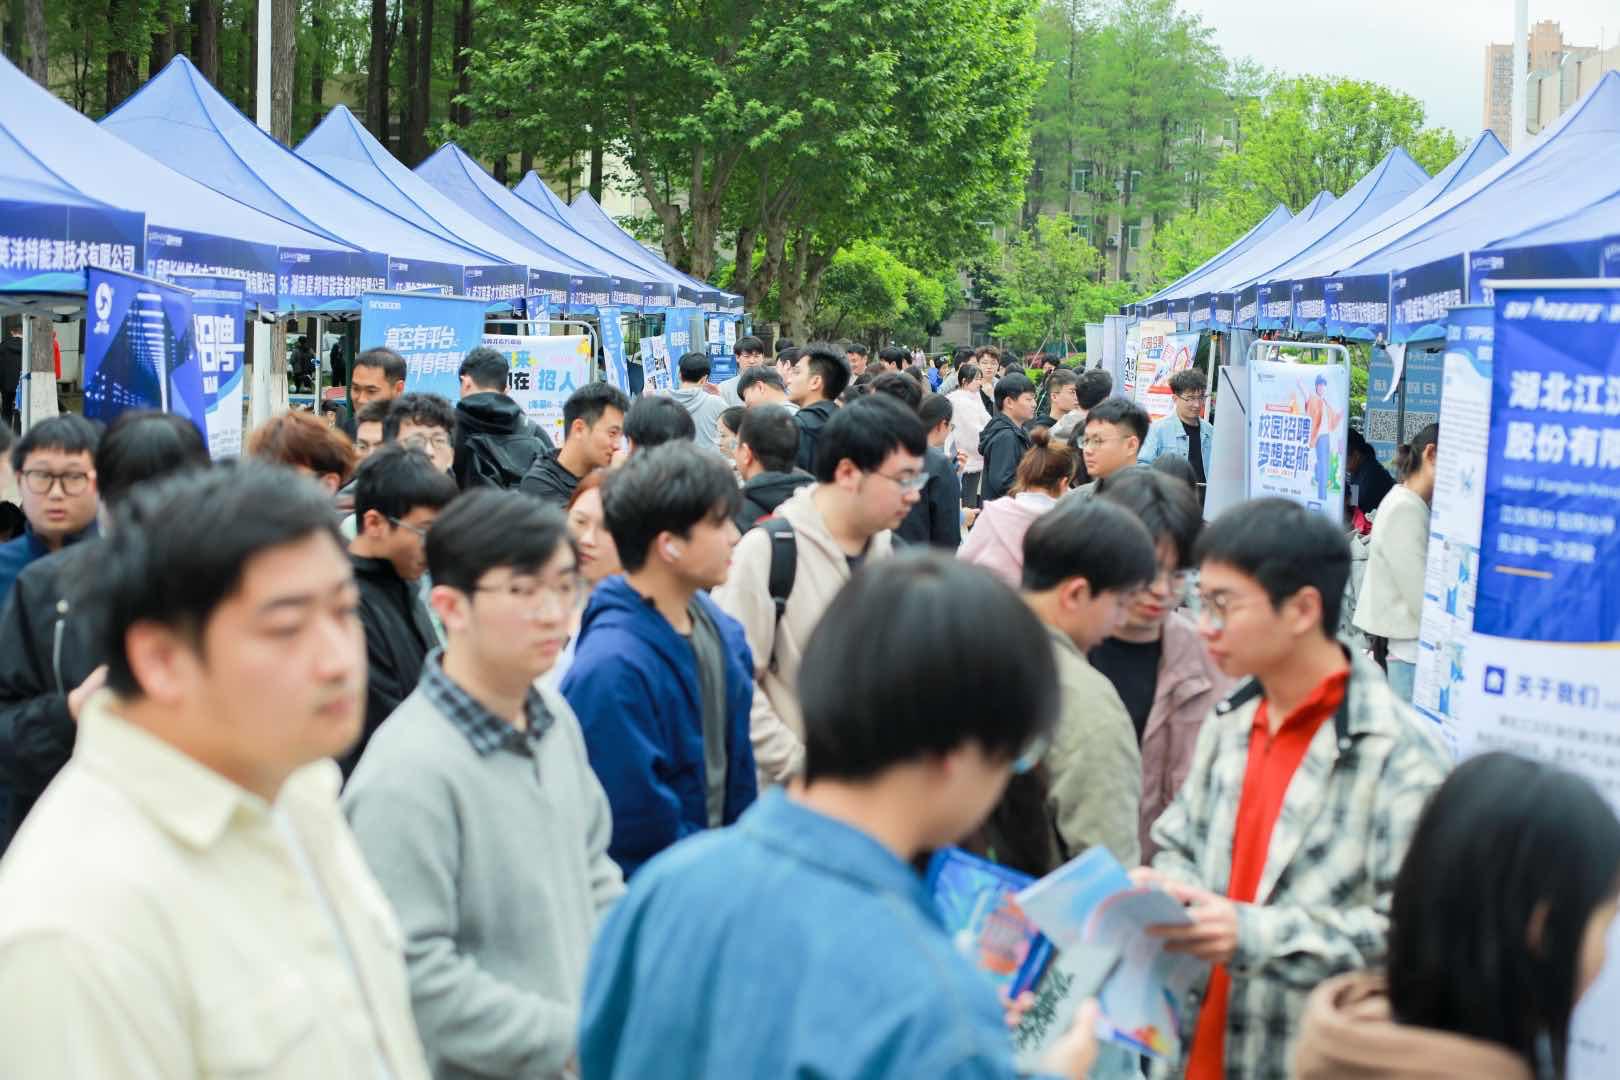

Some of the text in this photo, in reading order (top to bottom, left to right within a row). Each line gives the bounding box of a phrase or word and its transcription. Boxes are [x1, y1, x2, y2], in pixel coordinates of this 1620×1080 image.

[538, 369, 577, 393] 招人
[1257, 415, 1312, 444] 校园招聘
[1256, 440, 1311, 475] 梦想起航
[1515, 674, 1600, 710] 关于我们
